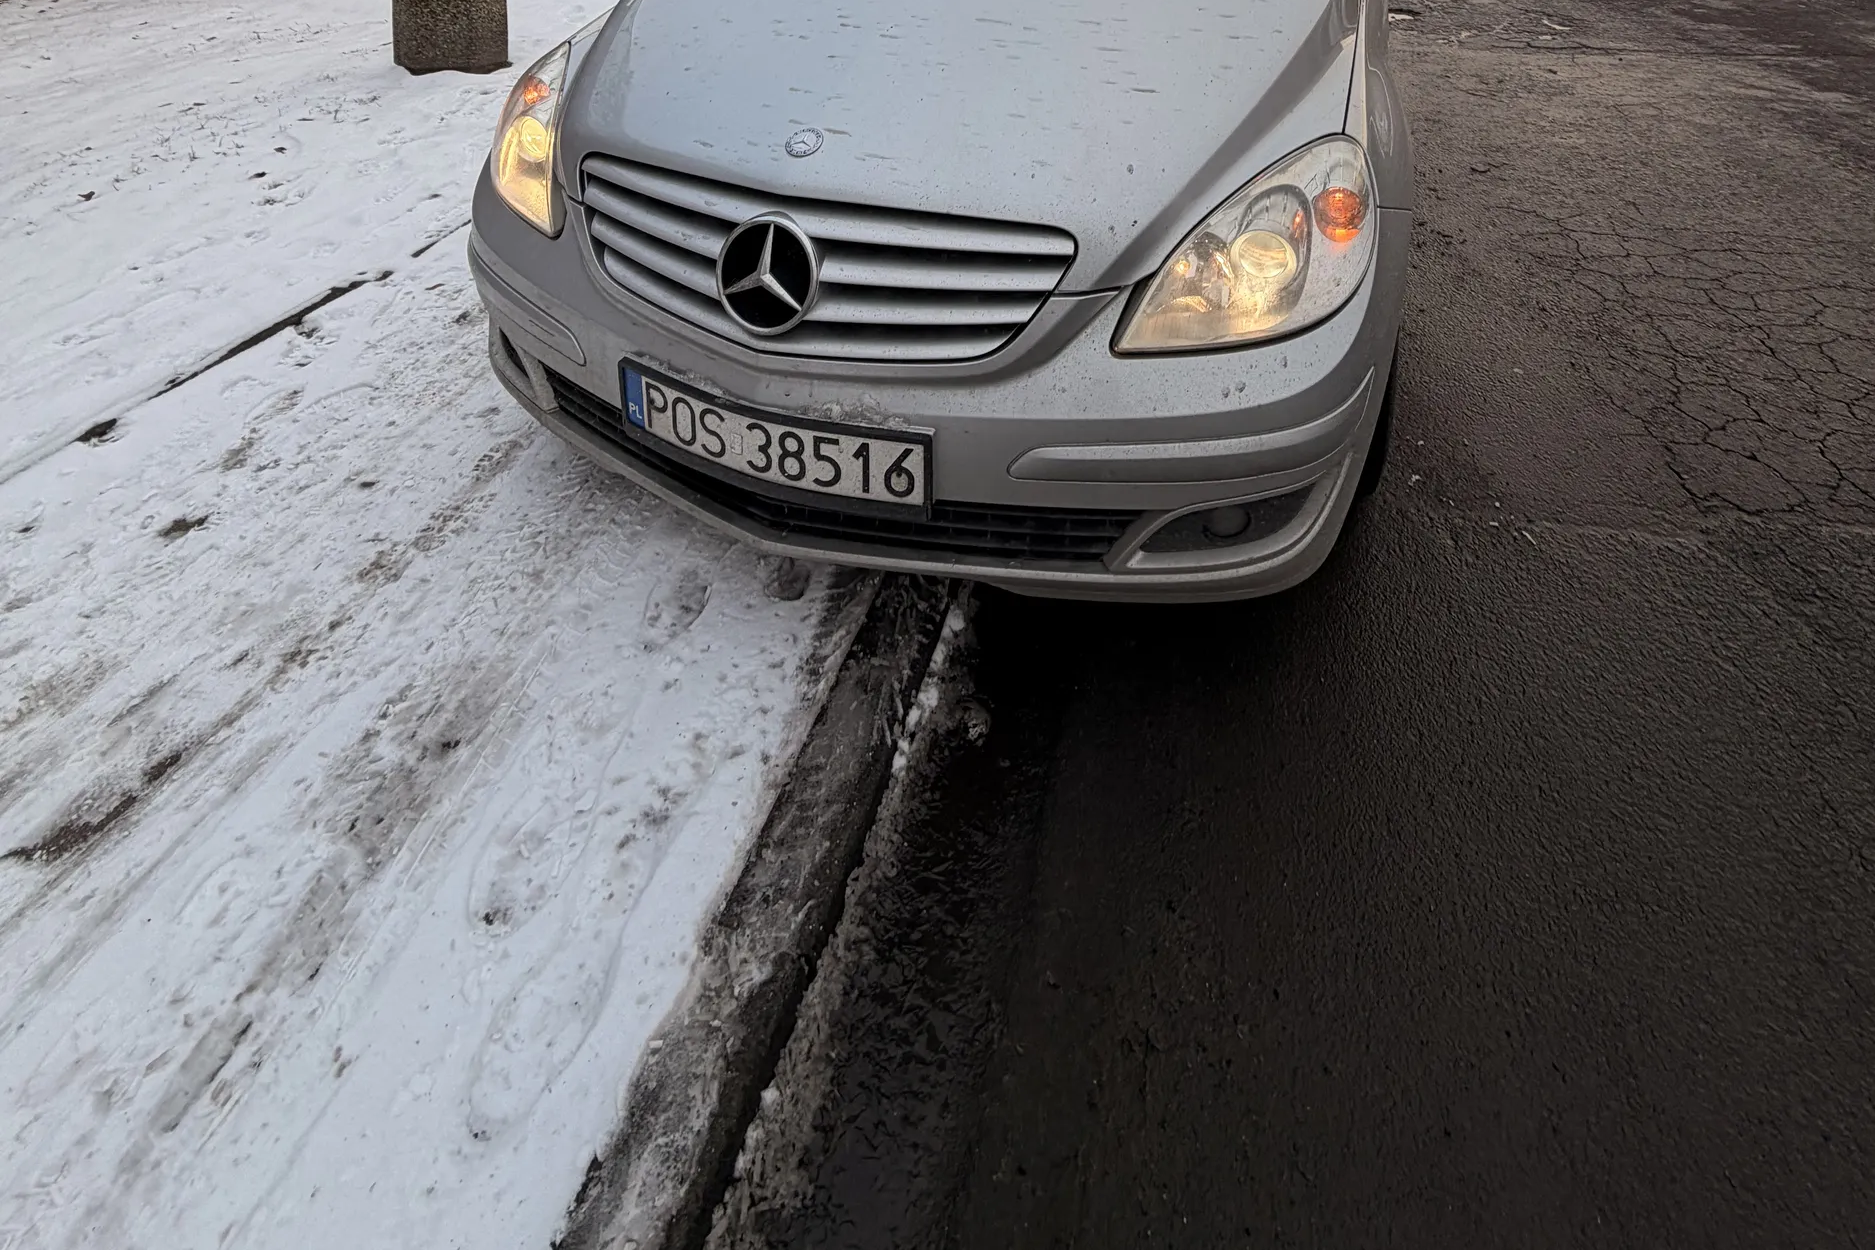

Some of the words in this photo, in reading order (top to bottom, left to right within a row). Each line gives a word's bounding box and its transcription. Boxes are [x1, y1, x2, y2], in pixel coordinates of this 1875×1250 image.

[629, 401, 642, 419] PL
[644, 381, 726, 459] POS
[745, 422, 916, 498] 38516
